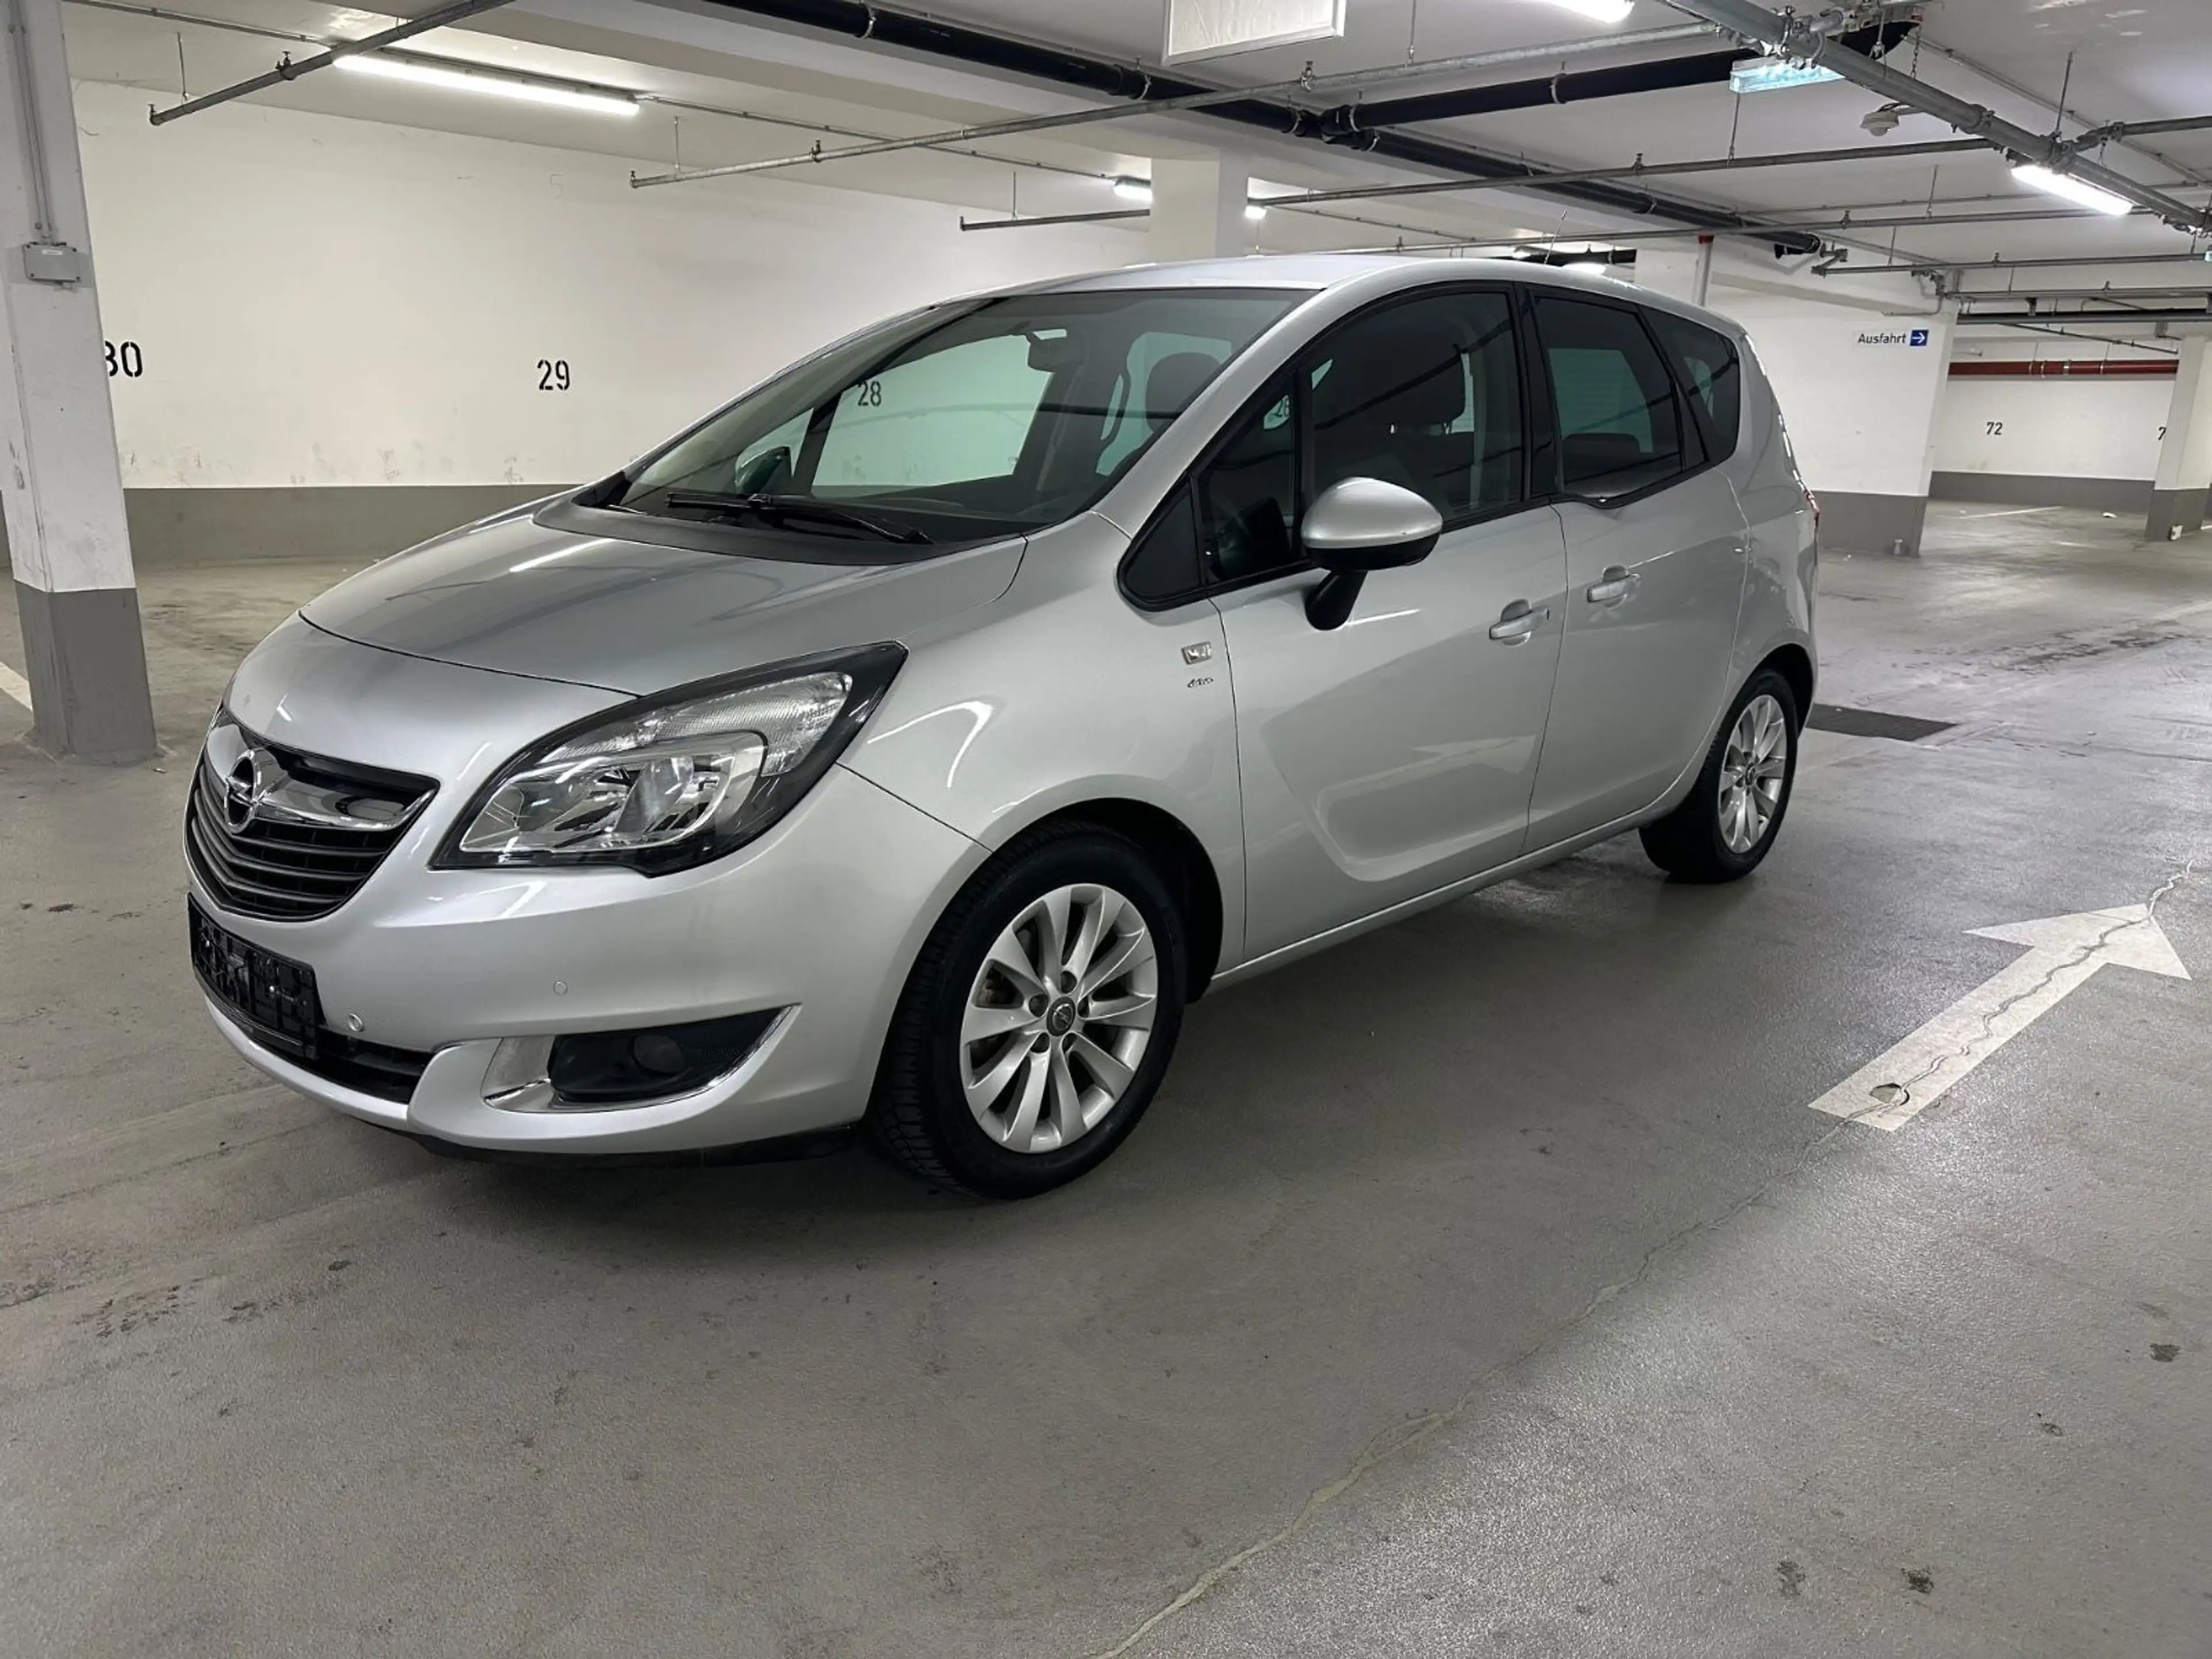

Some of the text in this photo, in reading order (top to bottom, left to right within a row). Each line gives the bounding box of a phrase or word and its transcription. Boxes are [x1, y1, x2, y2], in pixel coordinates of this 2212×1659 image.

[1858, 333, 1906, 344] Ausfahrt
[537, 359, 570, 390] 29
[857, 380, 881, 407] 28
[1987, 422, 2002, 435] 72
[2157, 426, 2167, 441] 7
